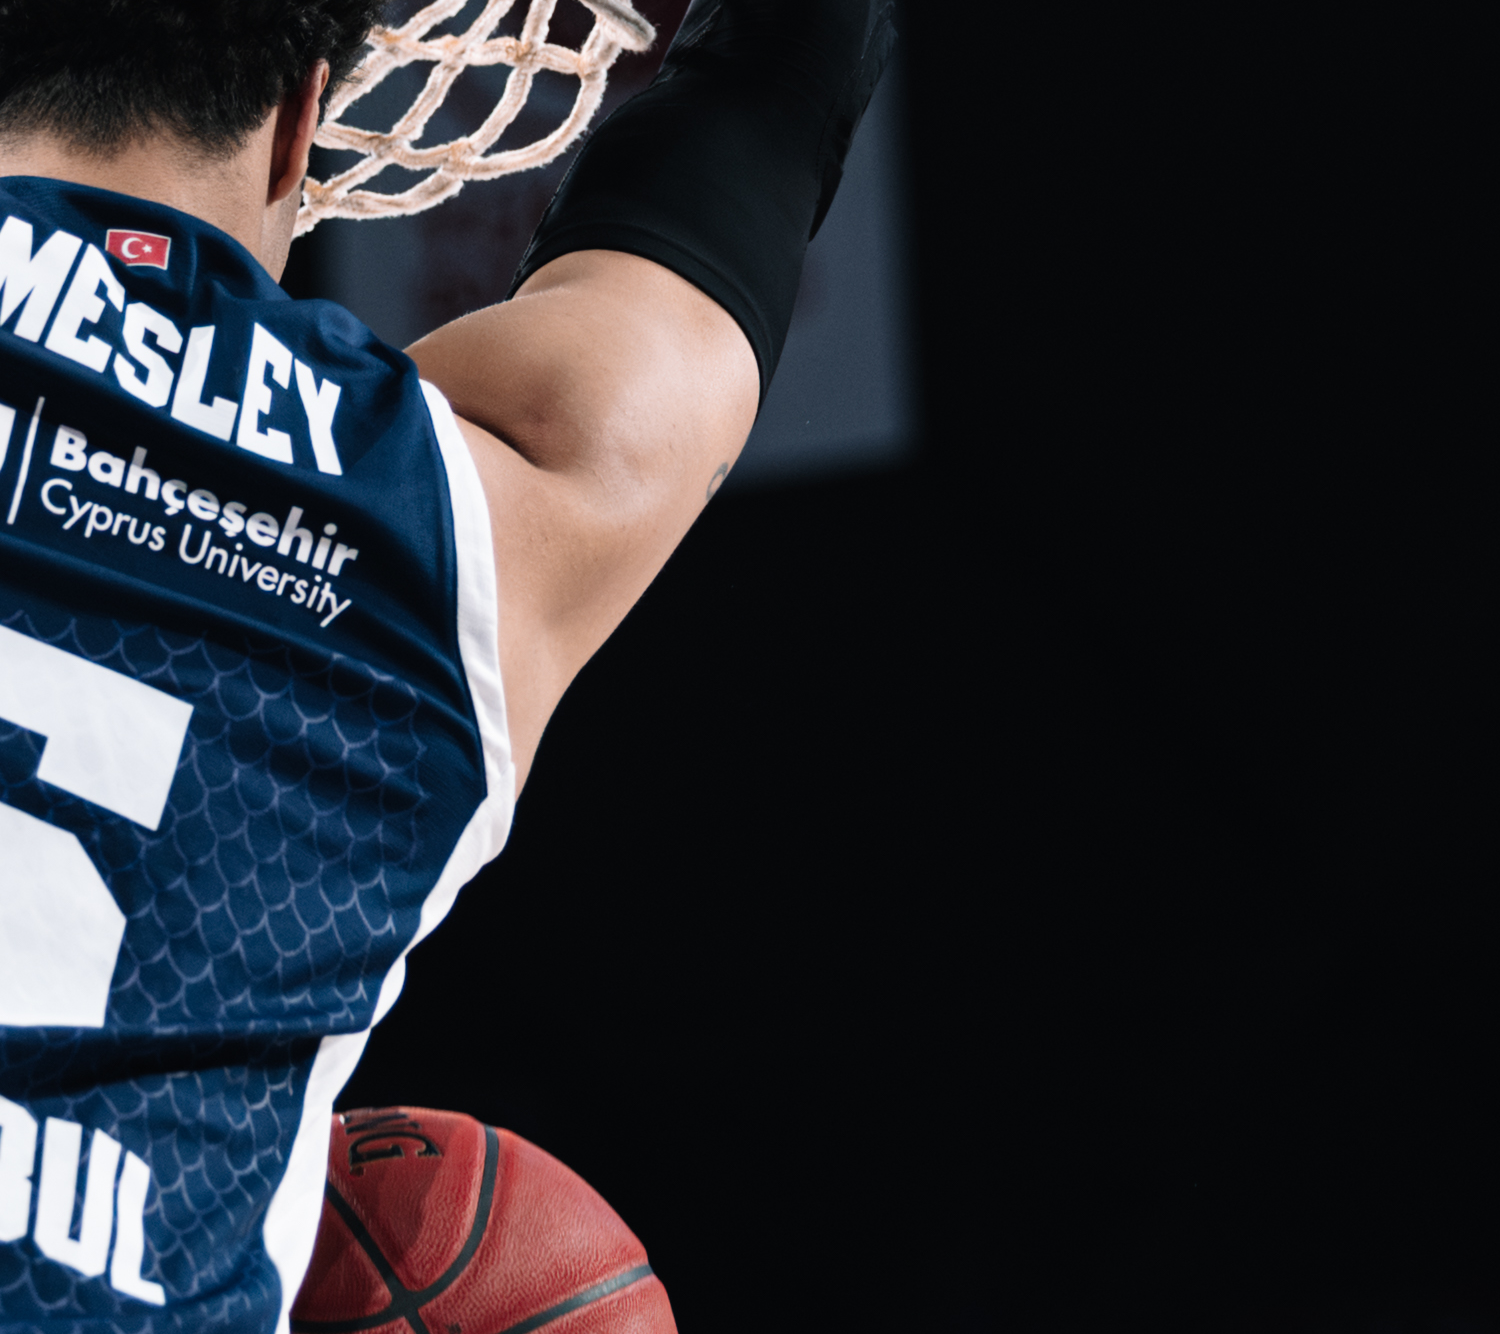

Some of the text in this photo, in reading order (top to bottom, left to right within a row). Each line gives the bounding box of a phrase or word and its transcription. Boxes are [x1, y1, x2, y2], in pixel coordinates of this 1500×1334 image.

[40, 477, 353, 628] Cyprus University
[49, 424, 359, 577] Bahçeşehir
